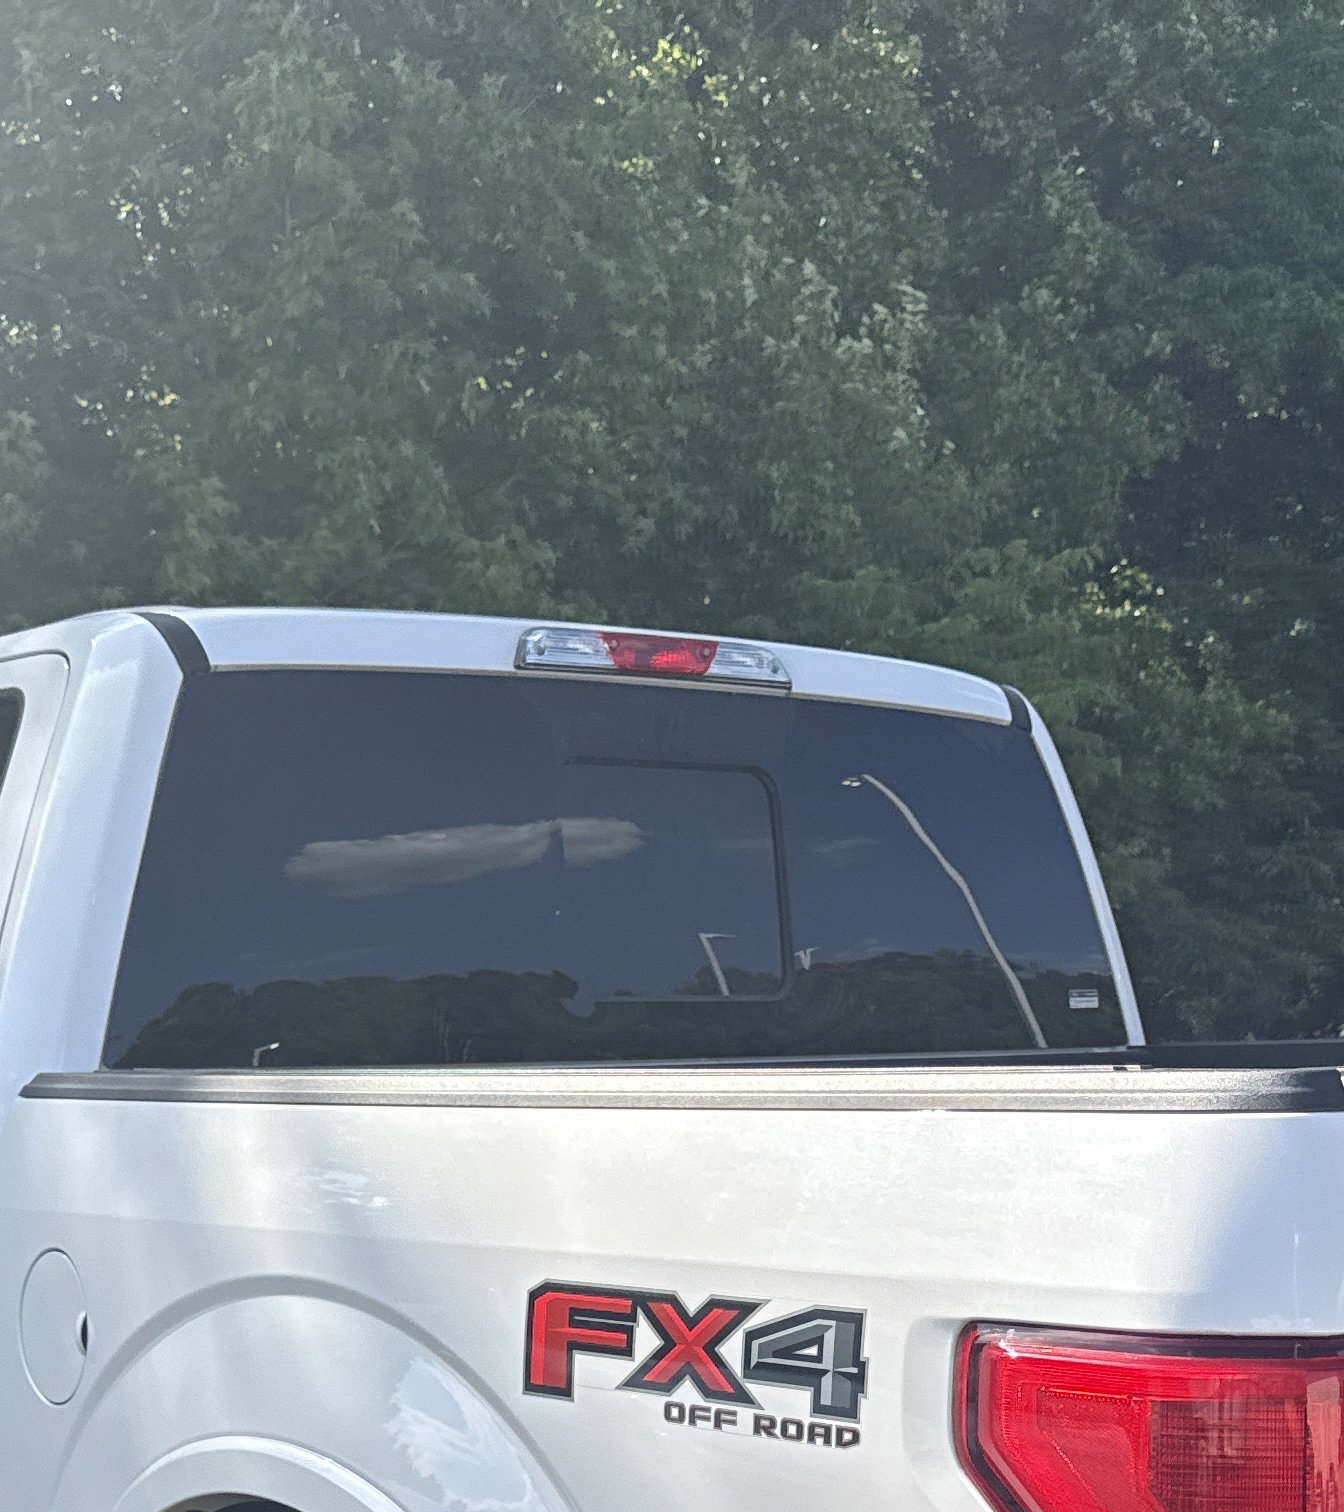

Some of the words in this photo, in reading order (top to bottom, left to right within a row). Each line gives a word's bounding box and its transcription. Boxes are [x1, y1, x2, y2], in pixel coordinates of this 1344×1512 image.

[522, 1279, 868, 1424] FX4
[663, 1400, 738, 1428] OFF
[753, 1413, 861, 1449] ROAD
